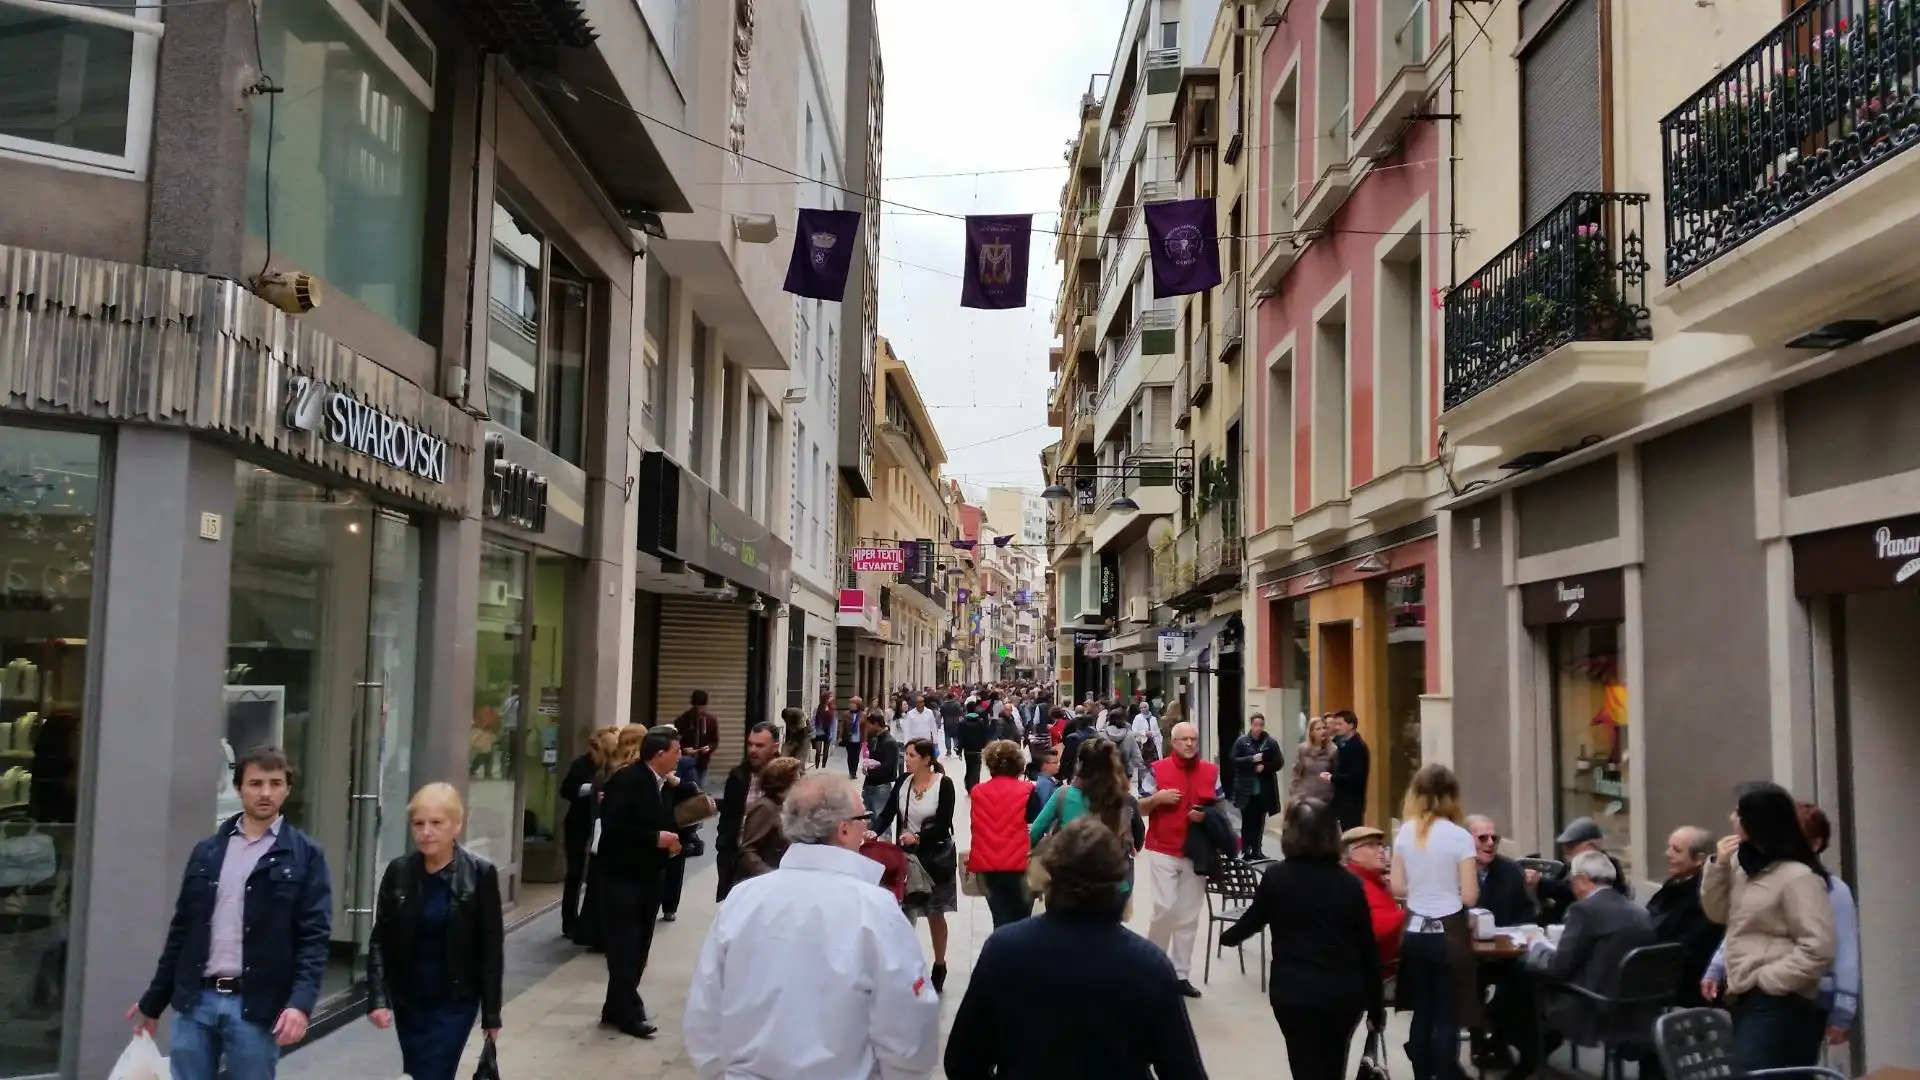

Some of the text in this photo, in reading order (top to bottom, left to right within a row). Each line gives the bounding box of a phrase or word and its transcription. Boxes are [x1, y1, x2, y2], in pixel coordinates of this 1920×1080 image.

[332, 392, 447, 484] SWAROVSKI
[853, 549, 903, 564] HIPER TEXTIL
[857, 562, 899, 571] LEVANTE
